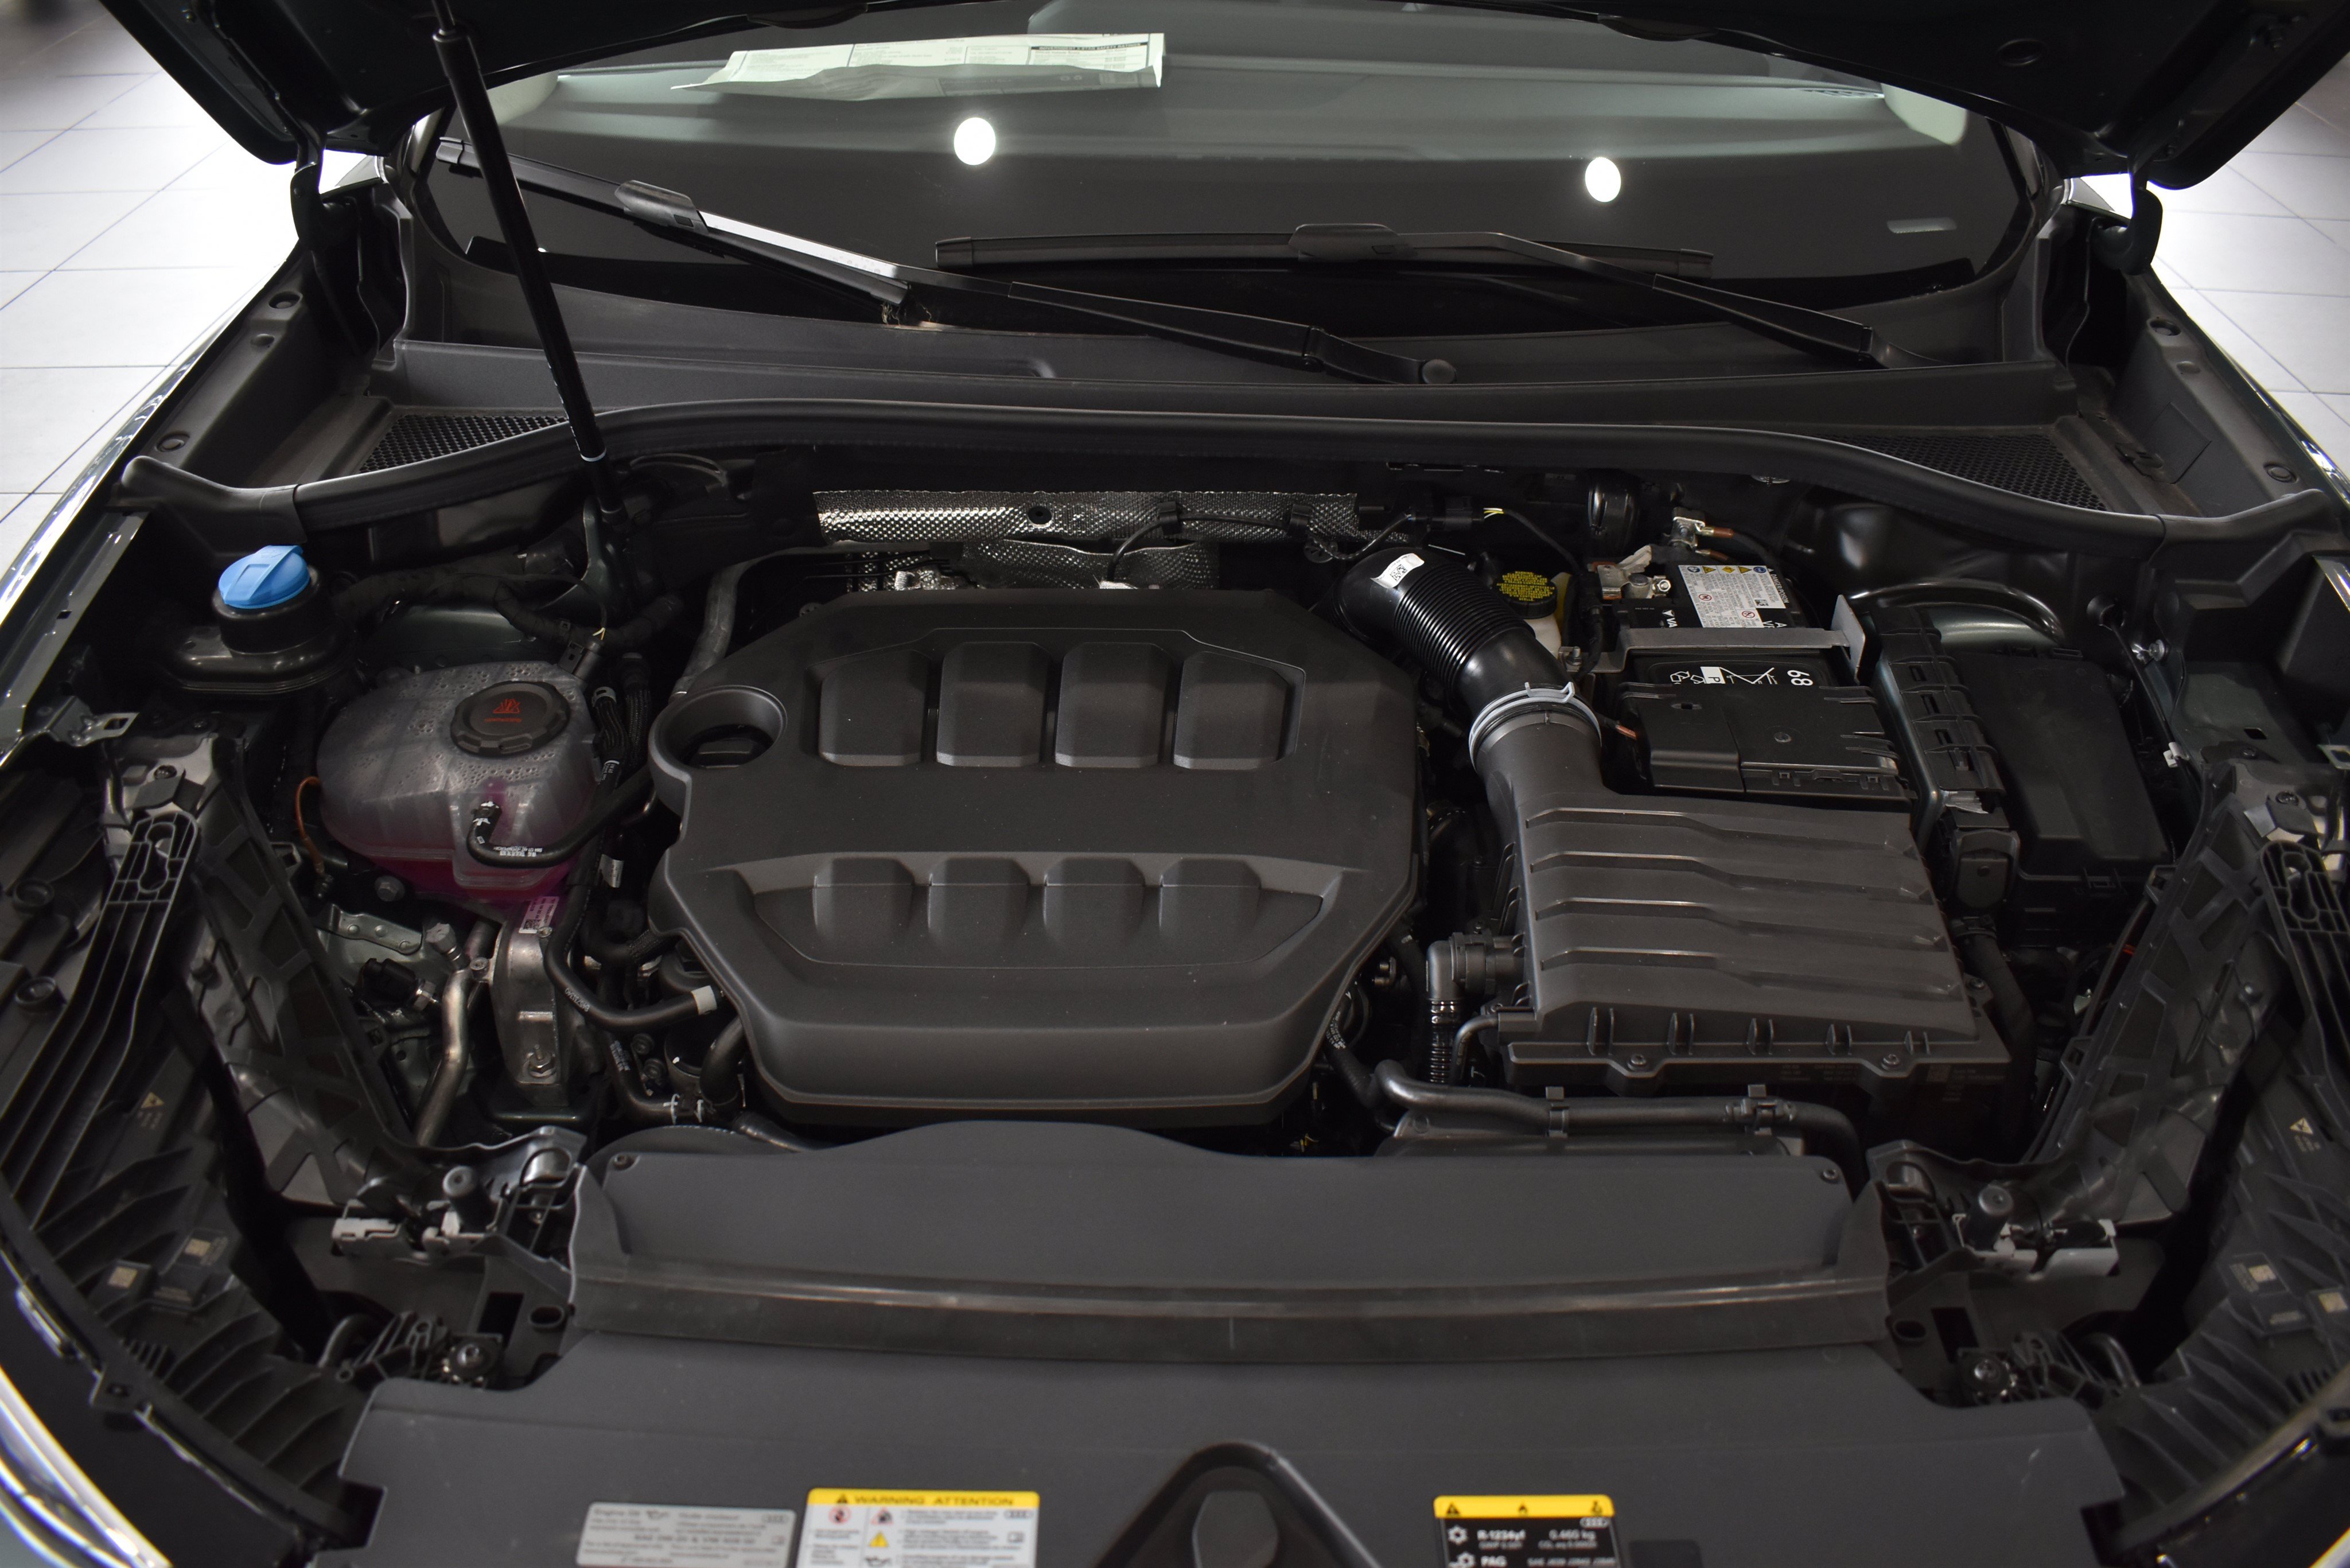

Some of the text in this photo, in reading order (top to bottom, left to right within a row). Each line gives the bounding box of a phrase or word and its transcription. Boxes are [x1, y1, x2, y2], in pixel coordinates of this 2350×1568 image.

[1787, 670, 1813, 686] 68
[855, 1496, 1014, 1505] WARNING ATTENTION
[1481, 1555, 1507, 1567] PAG
